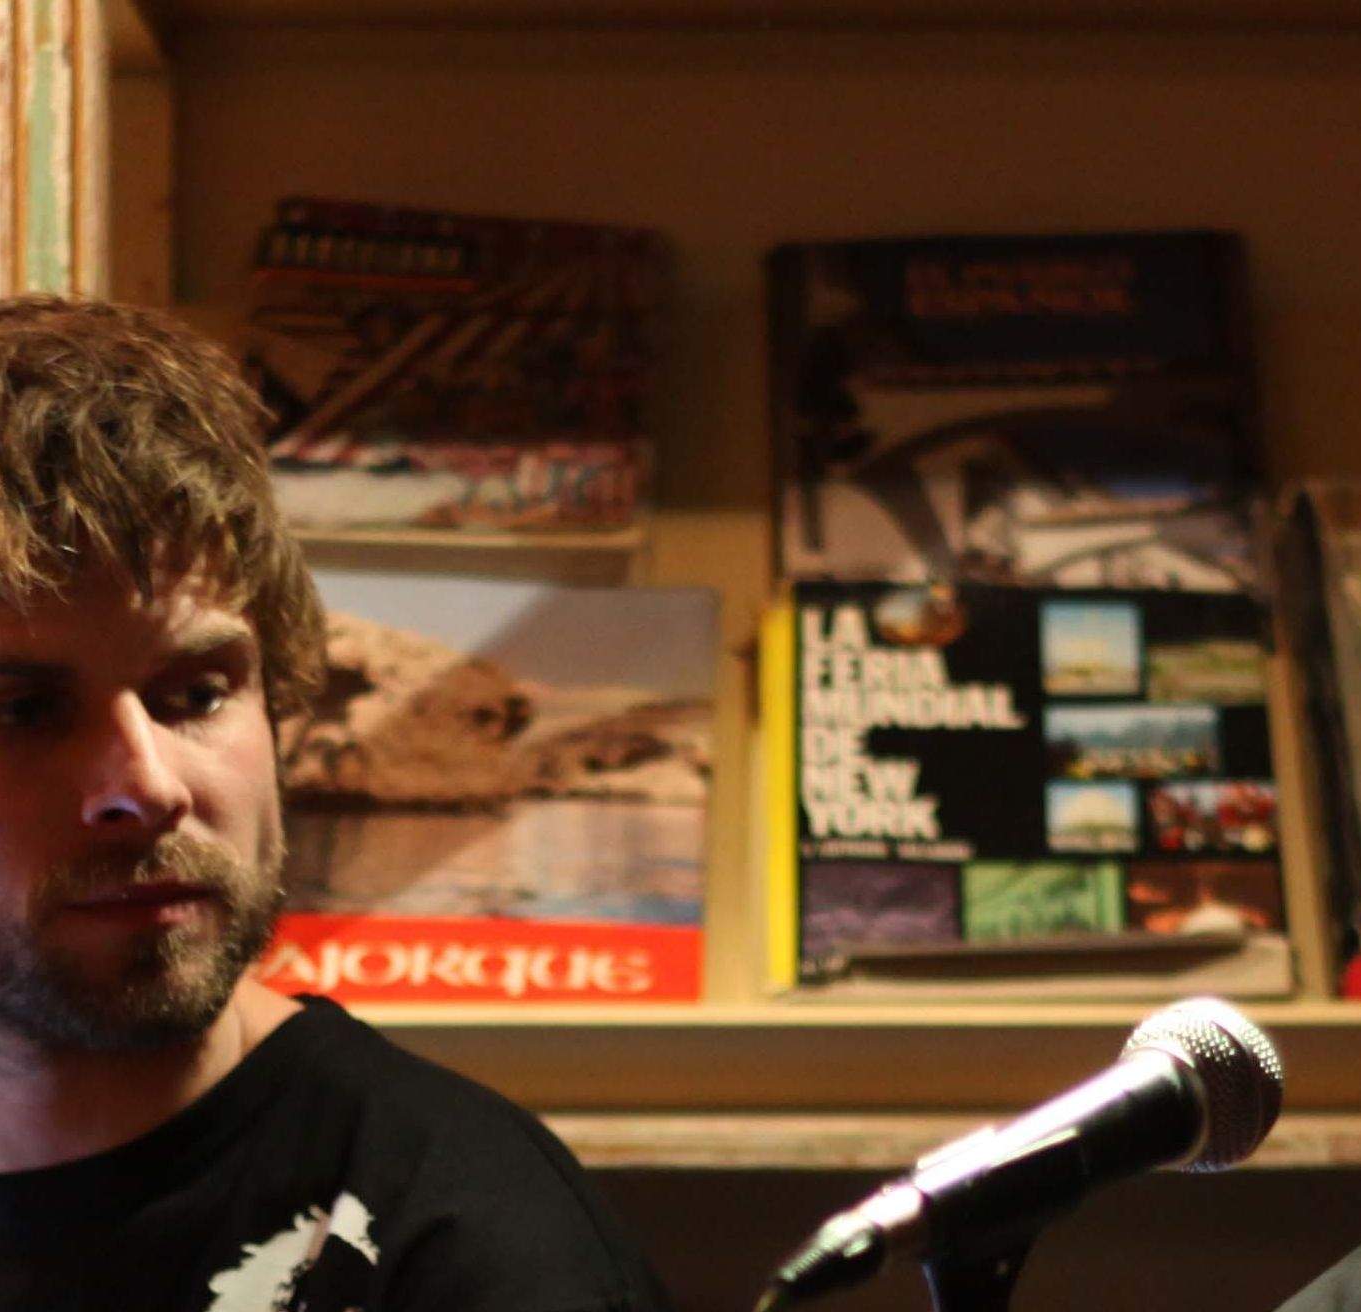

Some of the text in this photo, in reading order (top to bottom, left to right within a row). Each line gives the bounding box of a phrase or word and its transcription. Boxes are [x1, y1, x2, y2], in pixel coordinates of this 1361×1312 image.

[802, 606, 870, 648] LA
[802, 648, 948, 689] FERIA
[802, 686, 1027, 728] MUNDIAL
[802, 726, 868, 760] DE
[802, 758, 920, 801] NEW
[807, 798, 941, 839] YORK
